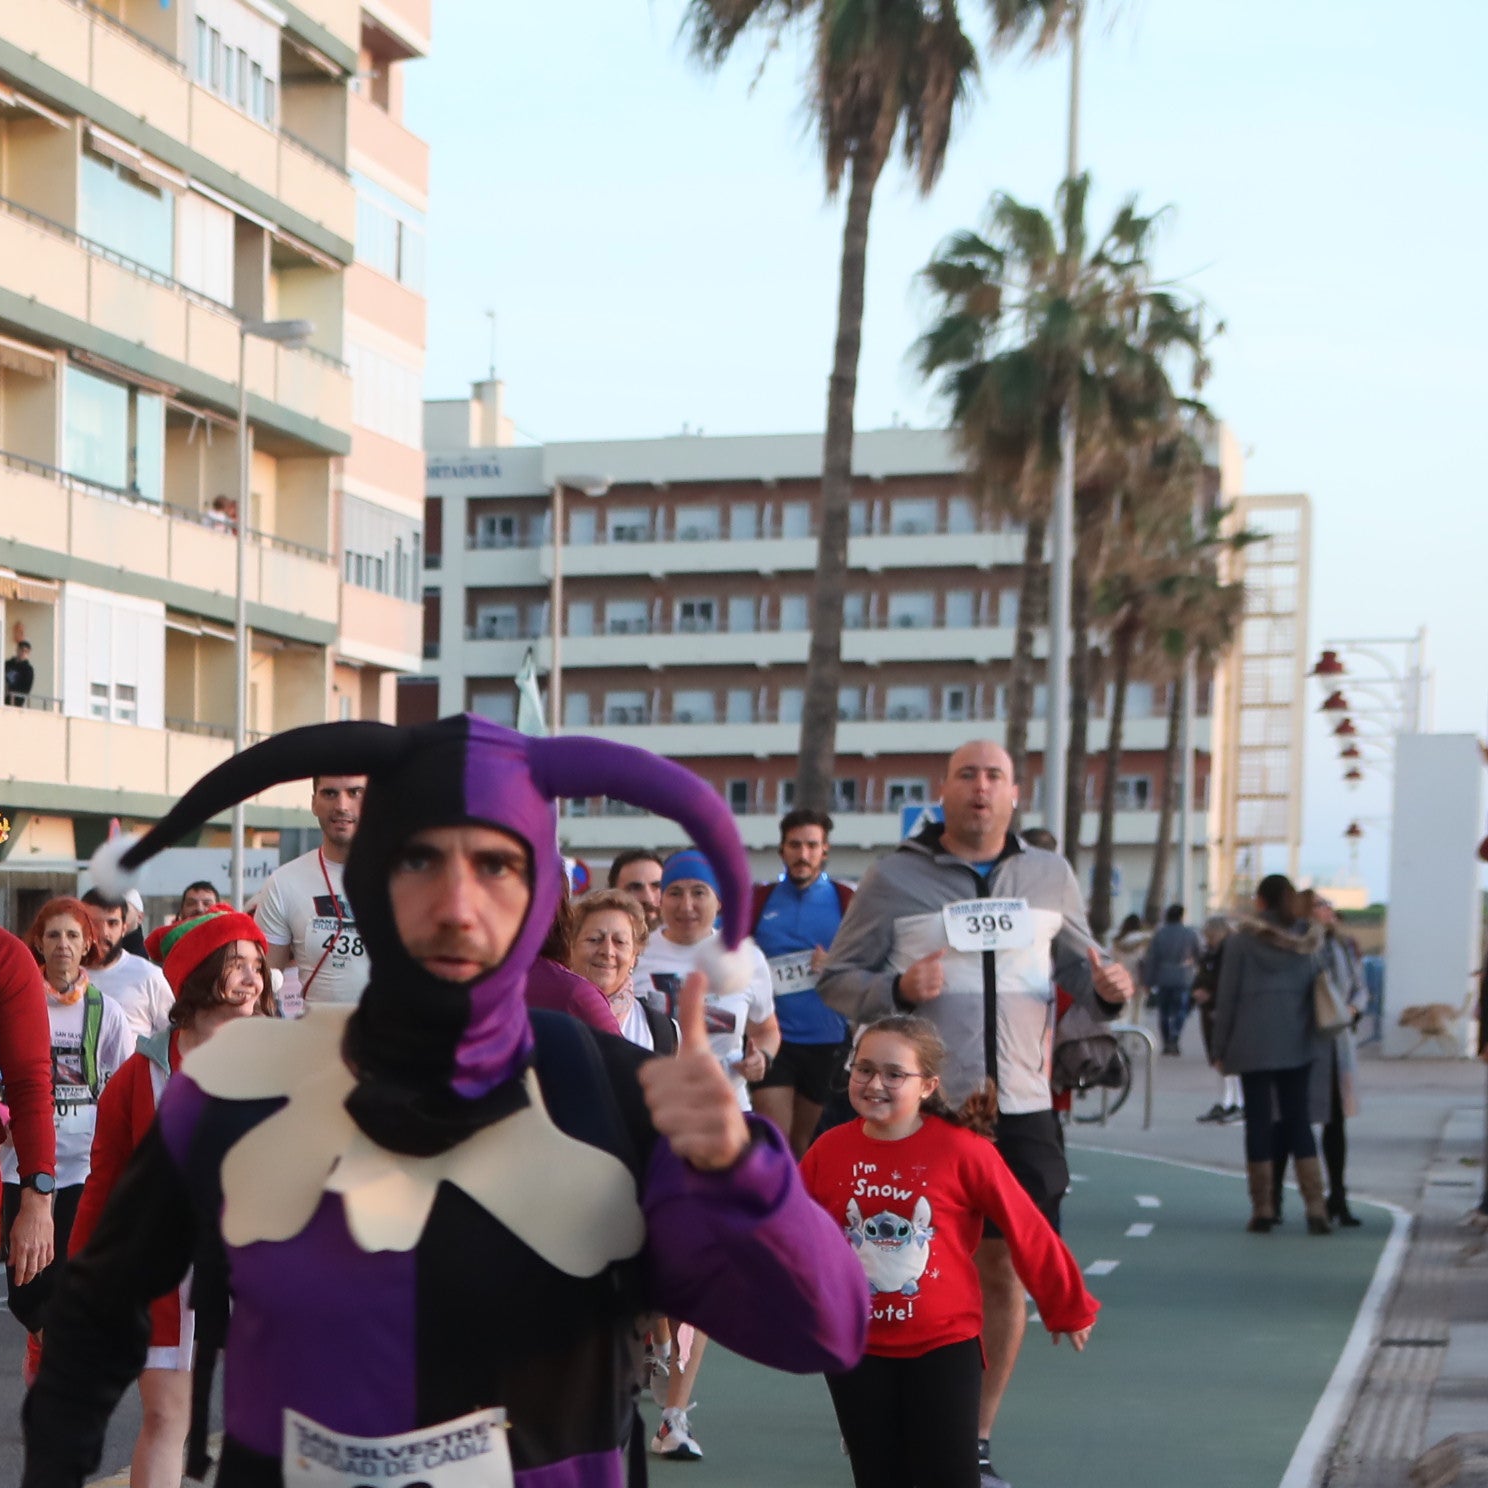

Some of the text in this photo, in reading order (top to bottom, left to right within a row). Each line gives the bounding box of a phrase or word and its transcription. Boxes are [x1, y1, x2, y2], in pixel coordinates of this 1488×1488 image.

[967, 915, 1012, 934] 396
[322, 934, 364, 956] 438
[853, 1162, 876, 1176] I'm
[854, 1179, 912, 1200] Snow
[868, 1302, 913, 1321] ute!
[345, 1421, 490, 1461] SILVESTRE
